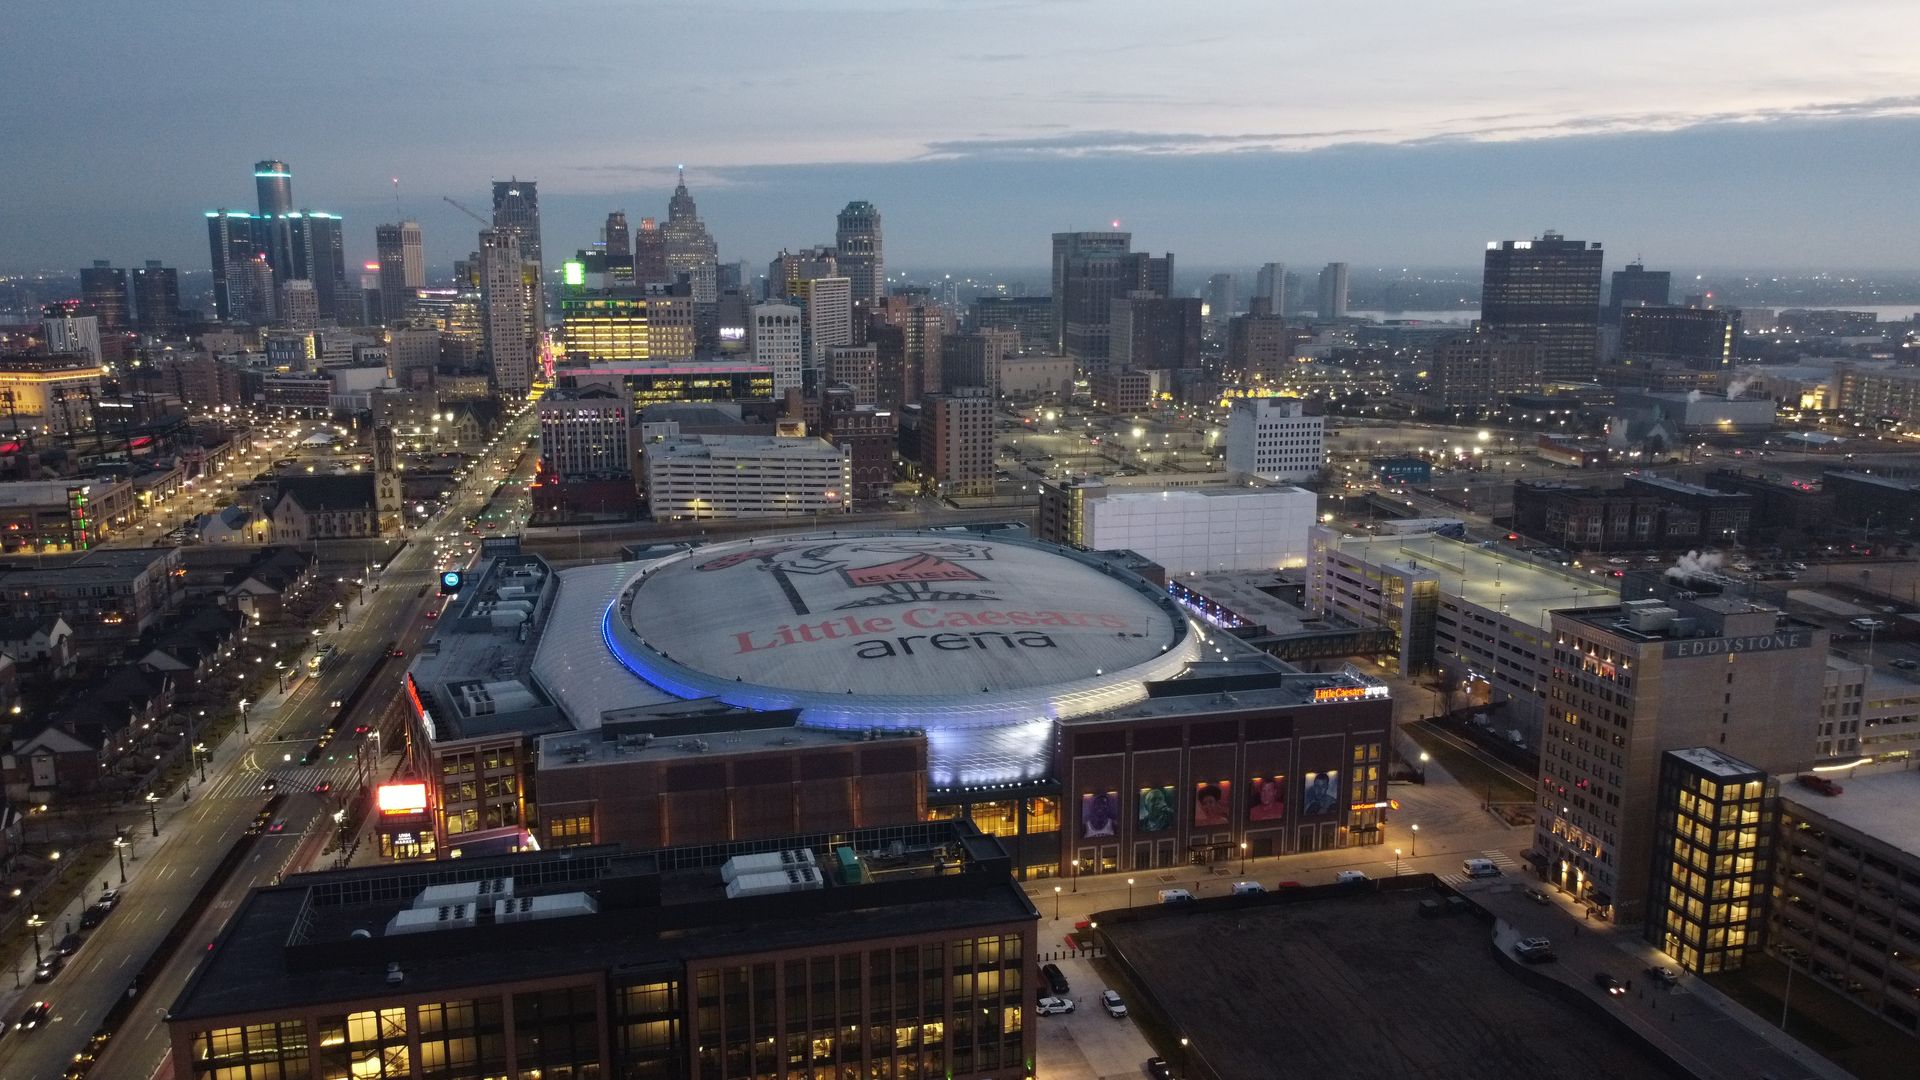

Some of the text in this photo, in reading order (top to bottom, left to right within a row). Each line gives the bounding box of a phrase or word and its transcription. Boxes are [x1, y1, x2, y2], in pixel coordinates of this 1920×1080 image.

[730, 606, 1128, 654] Little Caesars
[853, 631, 1058, 660] arena
[1678, 634, 1800, 656] EDDYSTONE
[1364, 686, 1388, 695] arena
